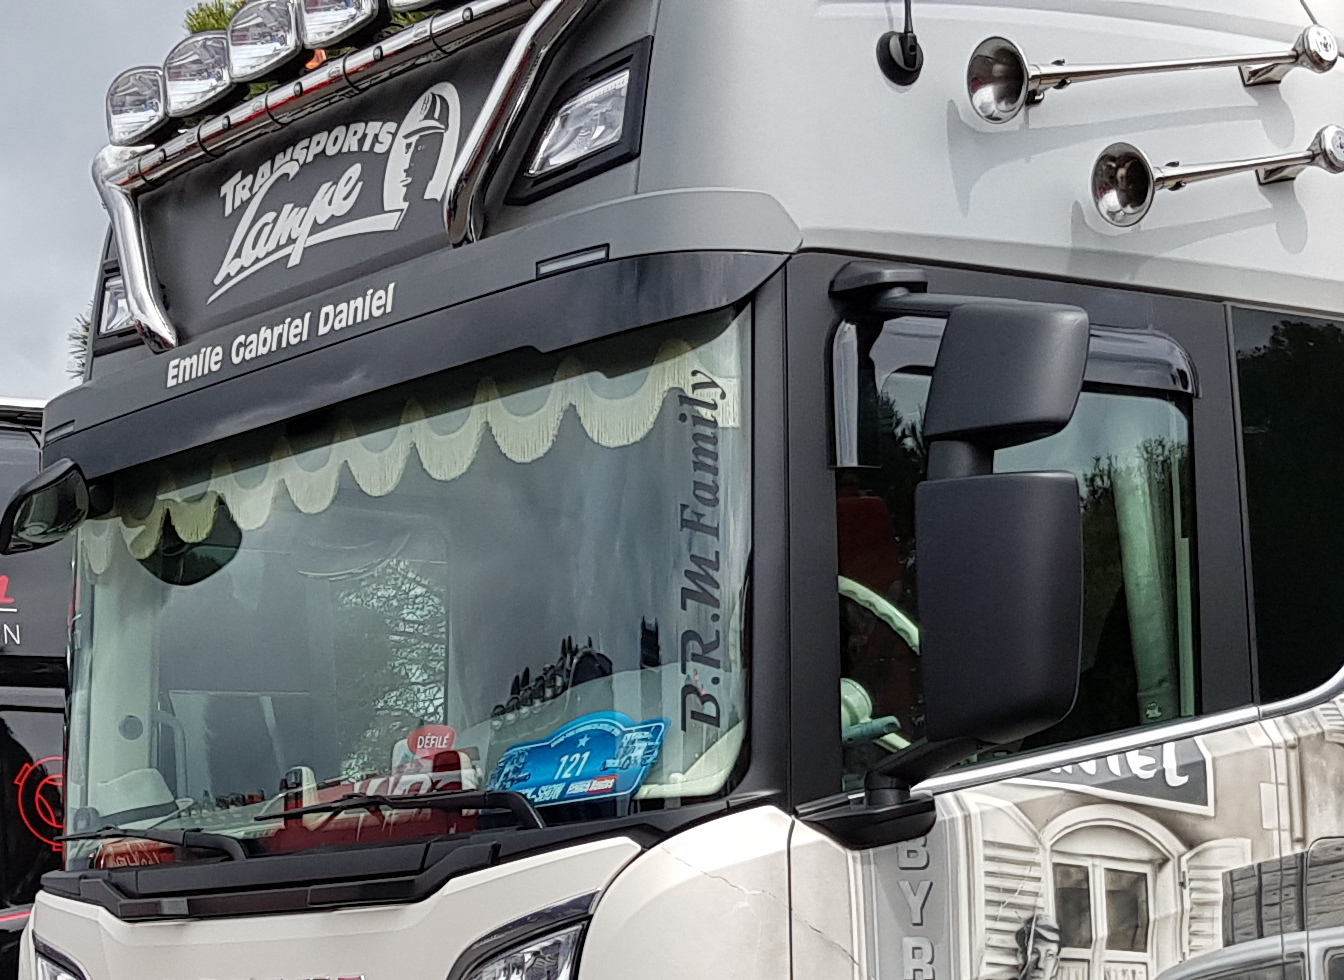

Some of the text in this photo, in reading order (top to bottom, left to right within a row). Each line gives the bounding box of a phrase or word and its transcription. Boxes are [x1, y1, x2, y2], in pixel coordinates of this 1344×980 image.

[220, 119, 398, 217] TRANSPORTS
[166, 283, 396, 388] Emile Gabriel Daniel
[678, 368, 727, 539] Family
[416, 732, 449, 750] DÉFILÉ
[554, 751, 591, 780] 121
